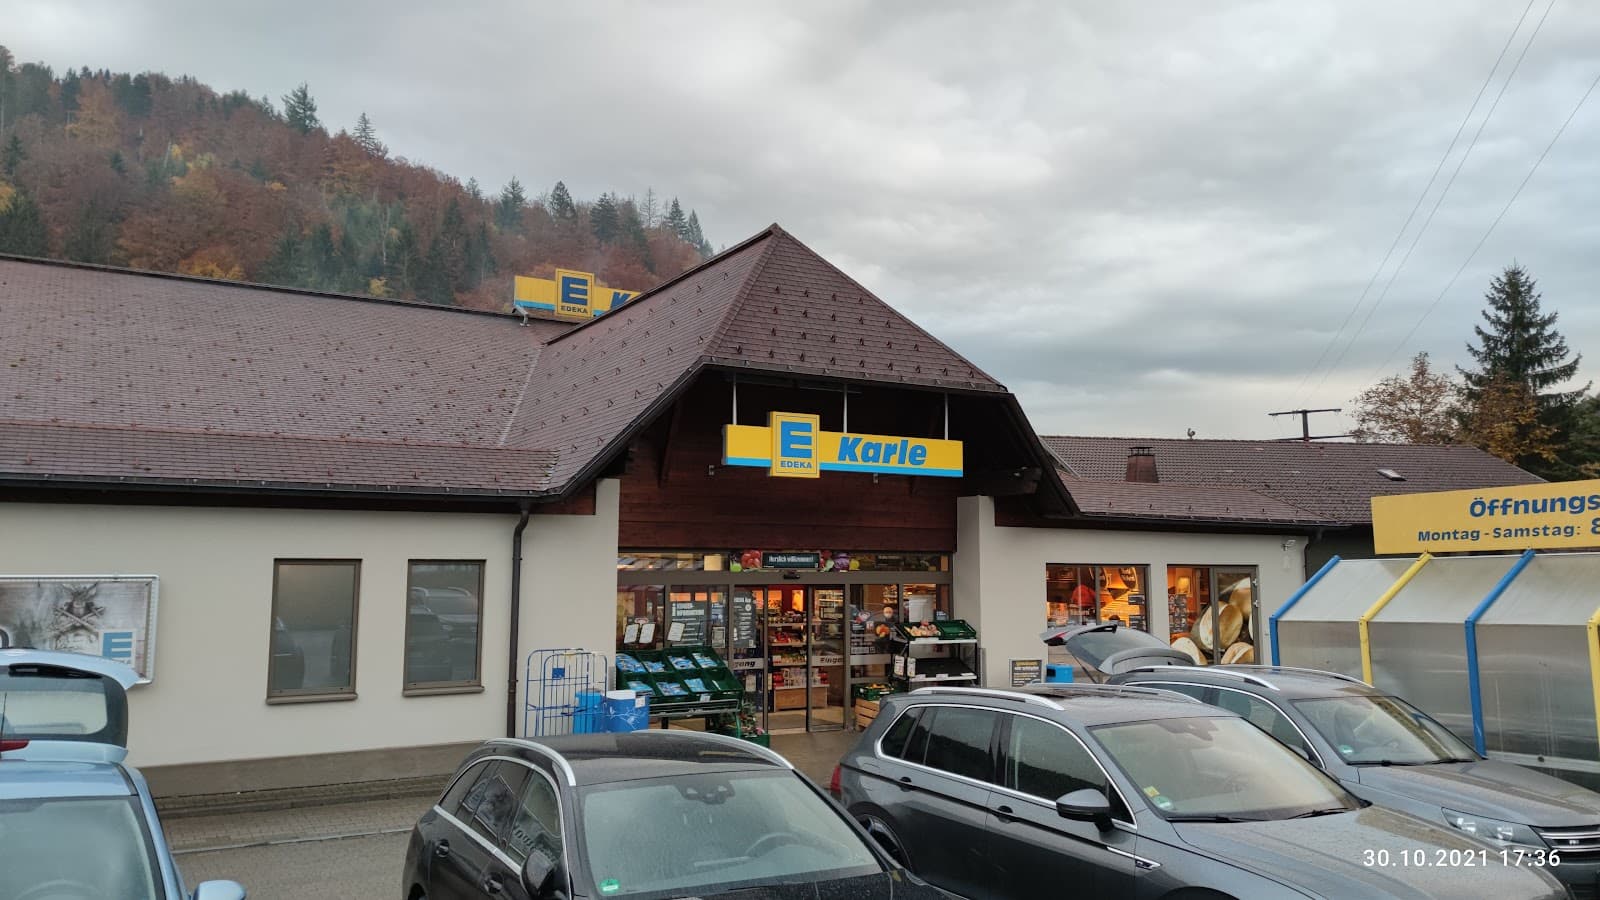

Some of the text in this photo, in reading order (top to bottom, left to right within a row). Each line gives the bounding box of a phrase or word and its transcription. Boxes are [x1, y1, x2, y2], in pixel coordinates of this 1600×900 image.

[561, 305, 588, 314] EDEKA
[838, 436, 927, 466] Karle
[780, 460, 812, 469] EDEKA
